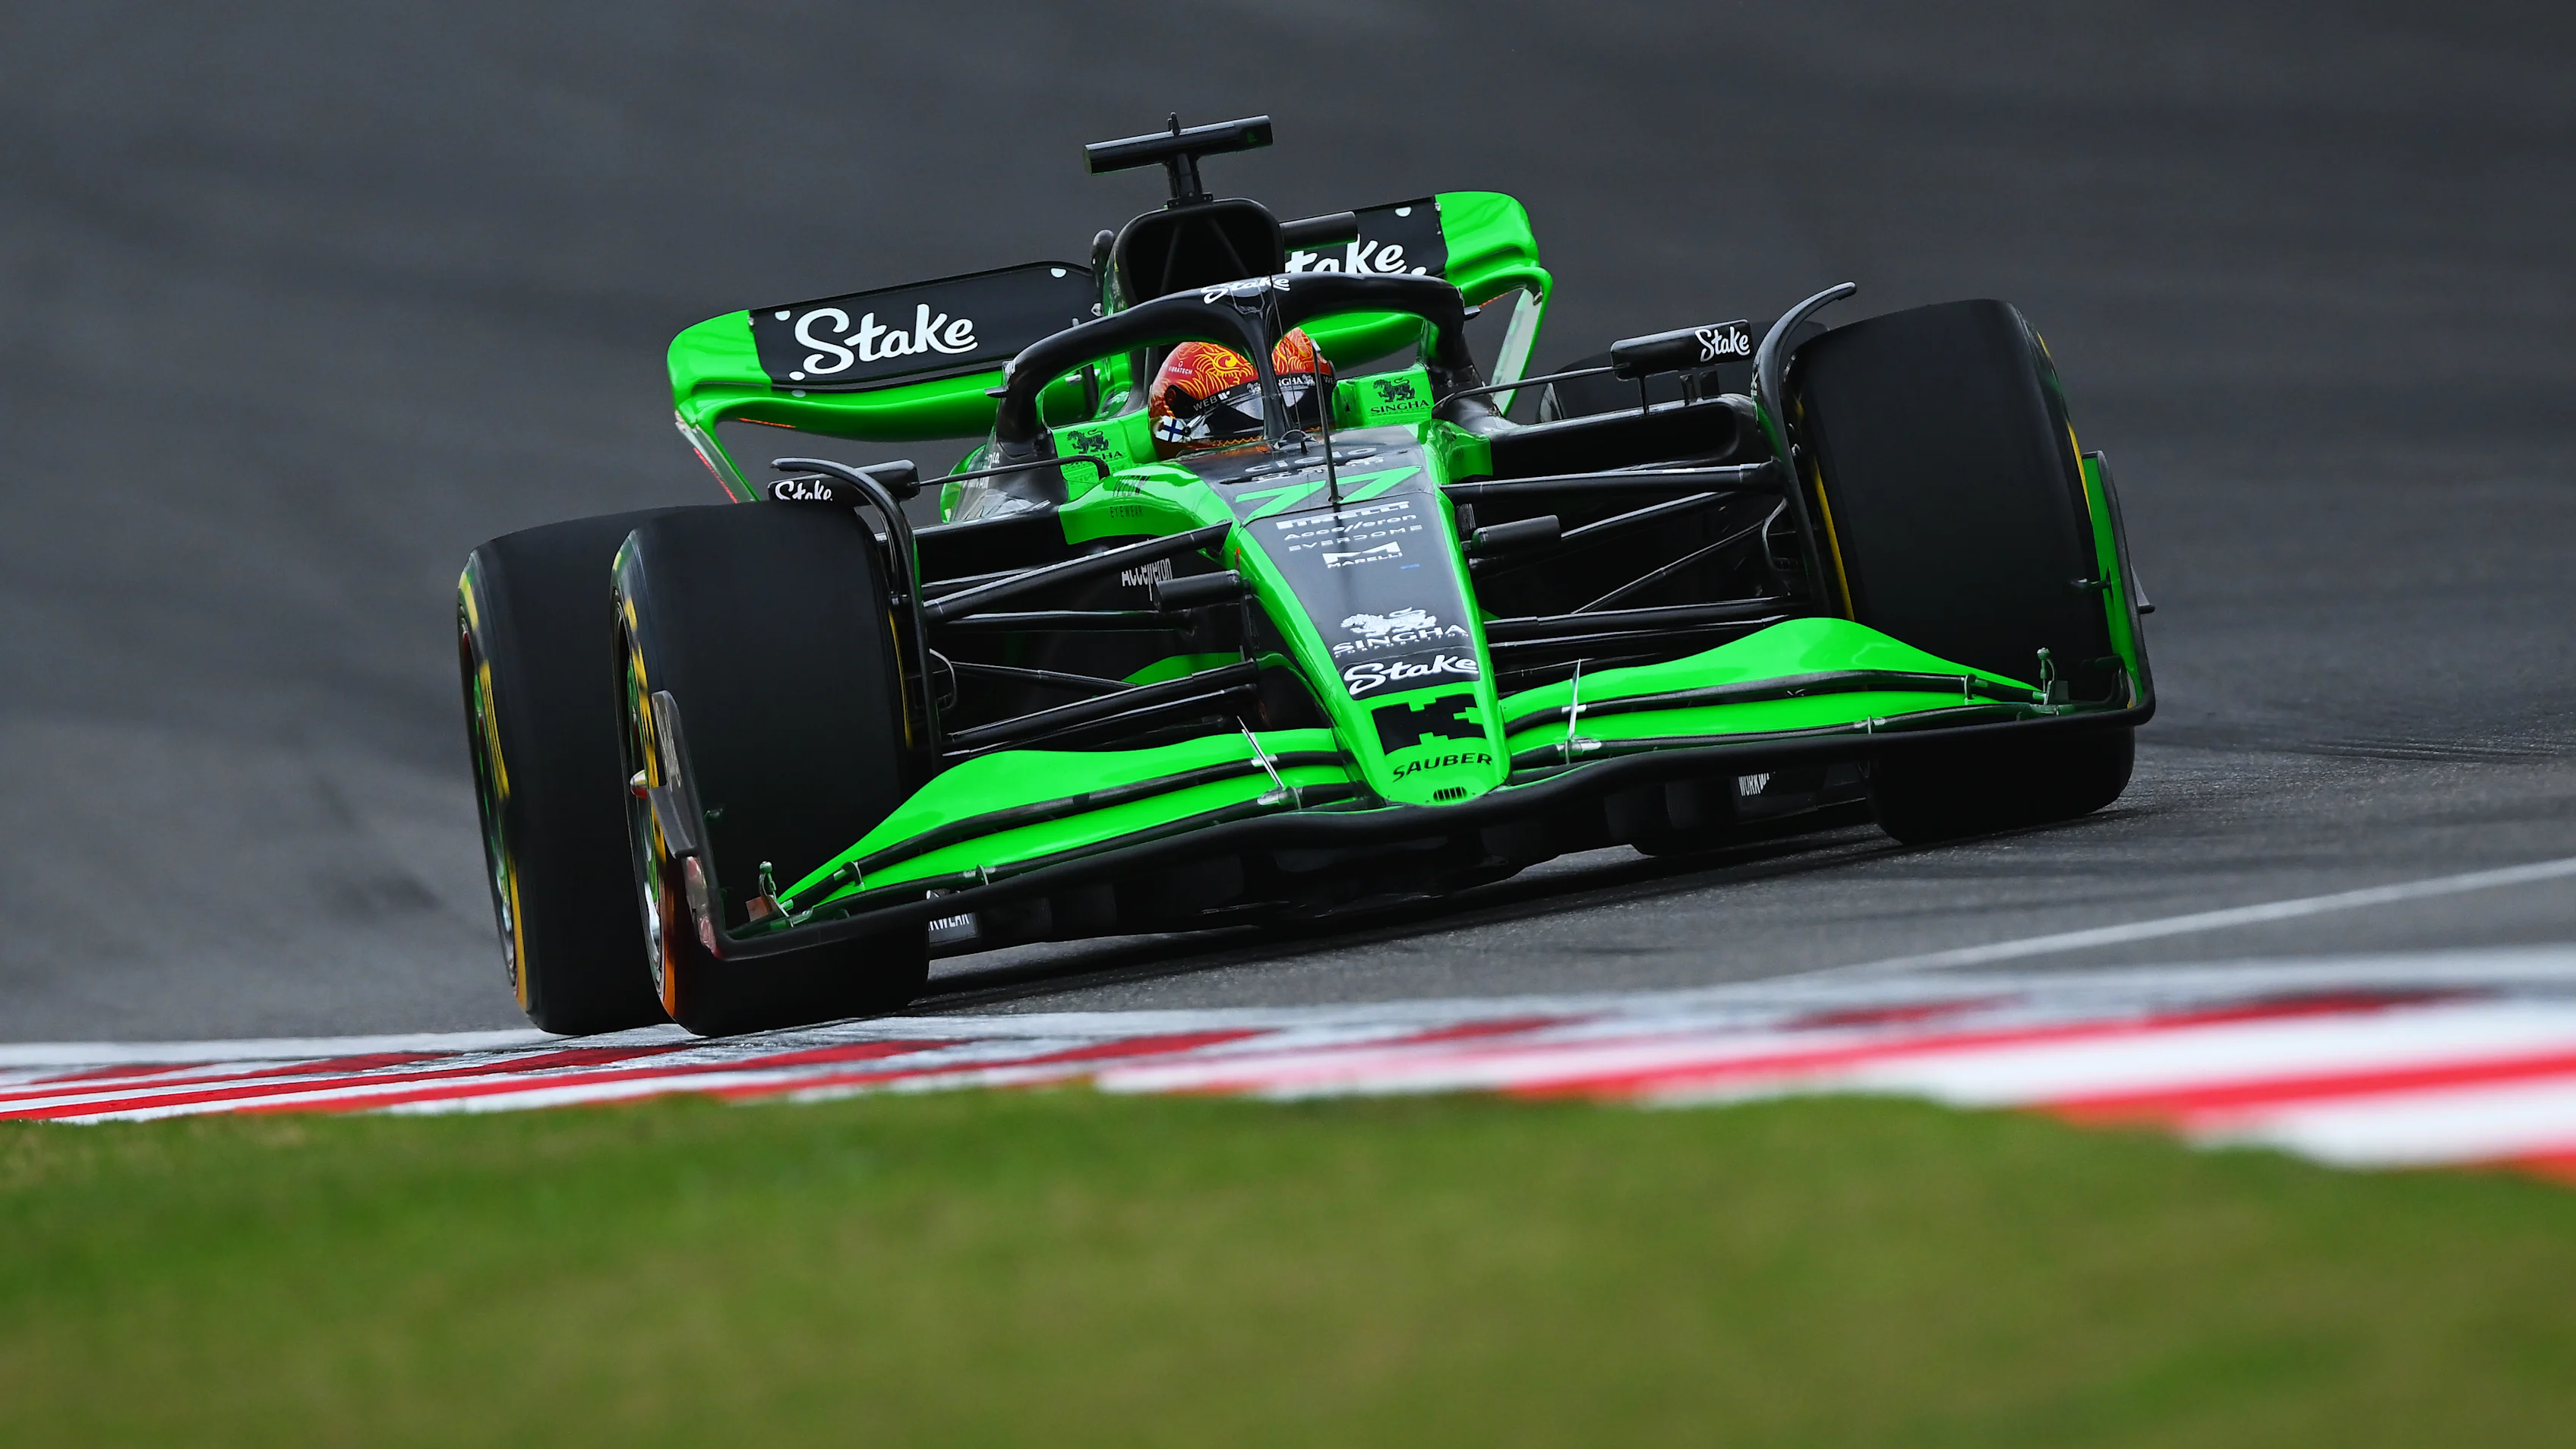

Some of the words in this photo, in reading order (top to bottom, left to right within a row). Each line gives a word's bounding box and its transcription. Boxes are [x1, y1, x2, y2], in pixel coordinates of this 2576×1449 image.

[1285, 233, 1407, 274] take
[1200, 277, 1290, 305] Stake
[794, 303, 978, 375] Stake
[1694, 326, 1750, 362] Stake
[1371, 399, 1429, 413] SINGHA
[1235, 465, 1422, 528] 77
[1276, 500, 1410, 530] PIRELLI
[1327, 552, 1403, 569] MARELLI
[1332, 624, 1468, 655] SINGHA
[1343, 655, 1479, 696] Stake
[1392, 752, 1492, 783] SAUBER
